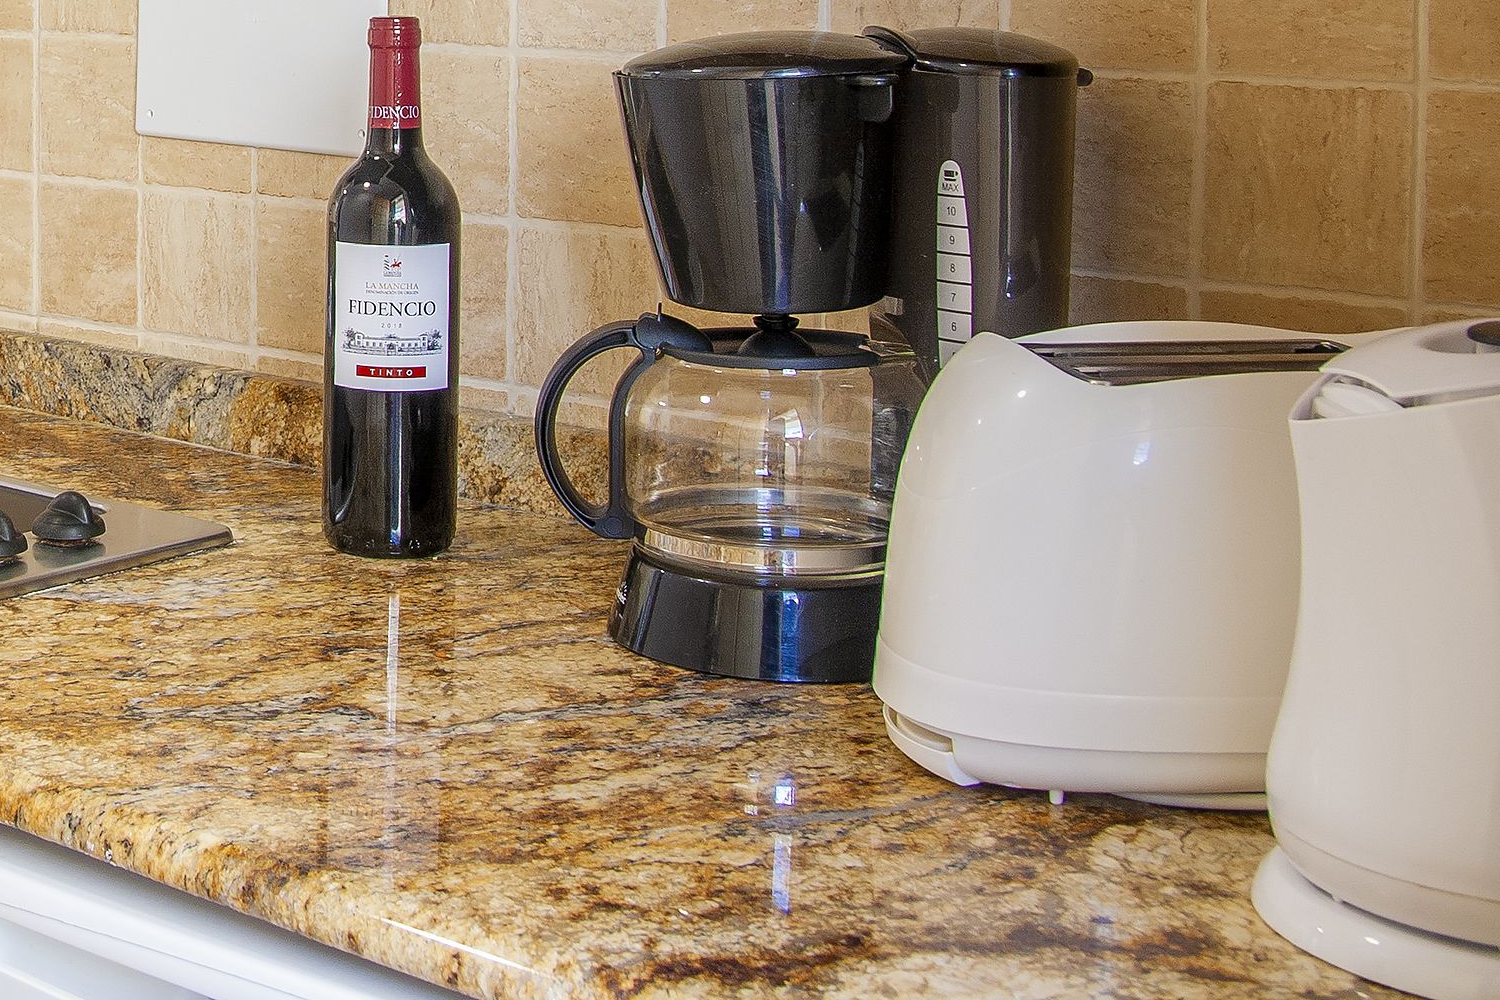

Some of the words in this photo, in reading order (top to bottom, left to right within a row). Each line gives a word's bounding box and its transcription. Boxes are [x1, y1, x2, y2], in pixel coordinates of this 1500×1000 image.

[370, 105, 420, 119] IDENCIO
[941, 182, 959, 192] MAX
[946, 206, 957, 217] 10
[948, 235, 956, 245] 9
[949, 263, 956, 273] 8
[378, 282, 420, 291] MANCHA
[950, 292, 957, 302] 7
[349, 299, 437, 317] FIDENCIO
[951, 322, 957, 332] 6
[369, 368, 414, 376] TINTO
